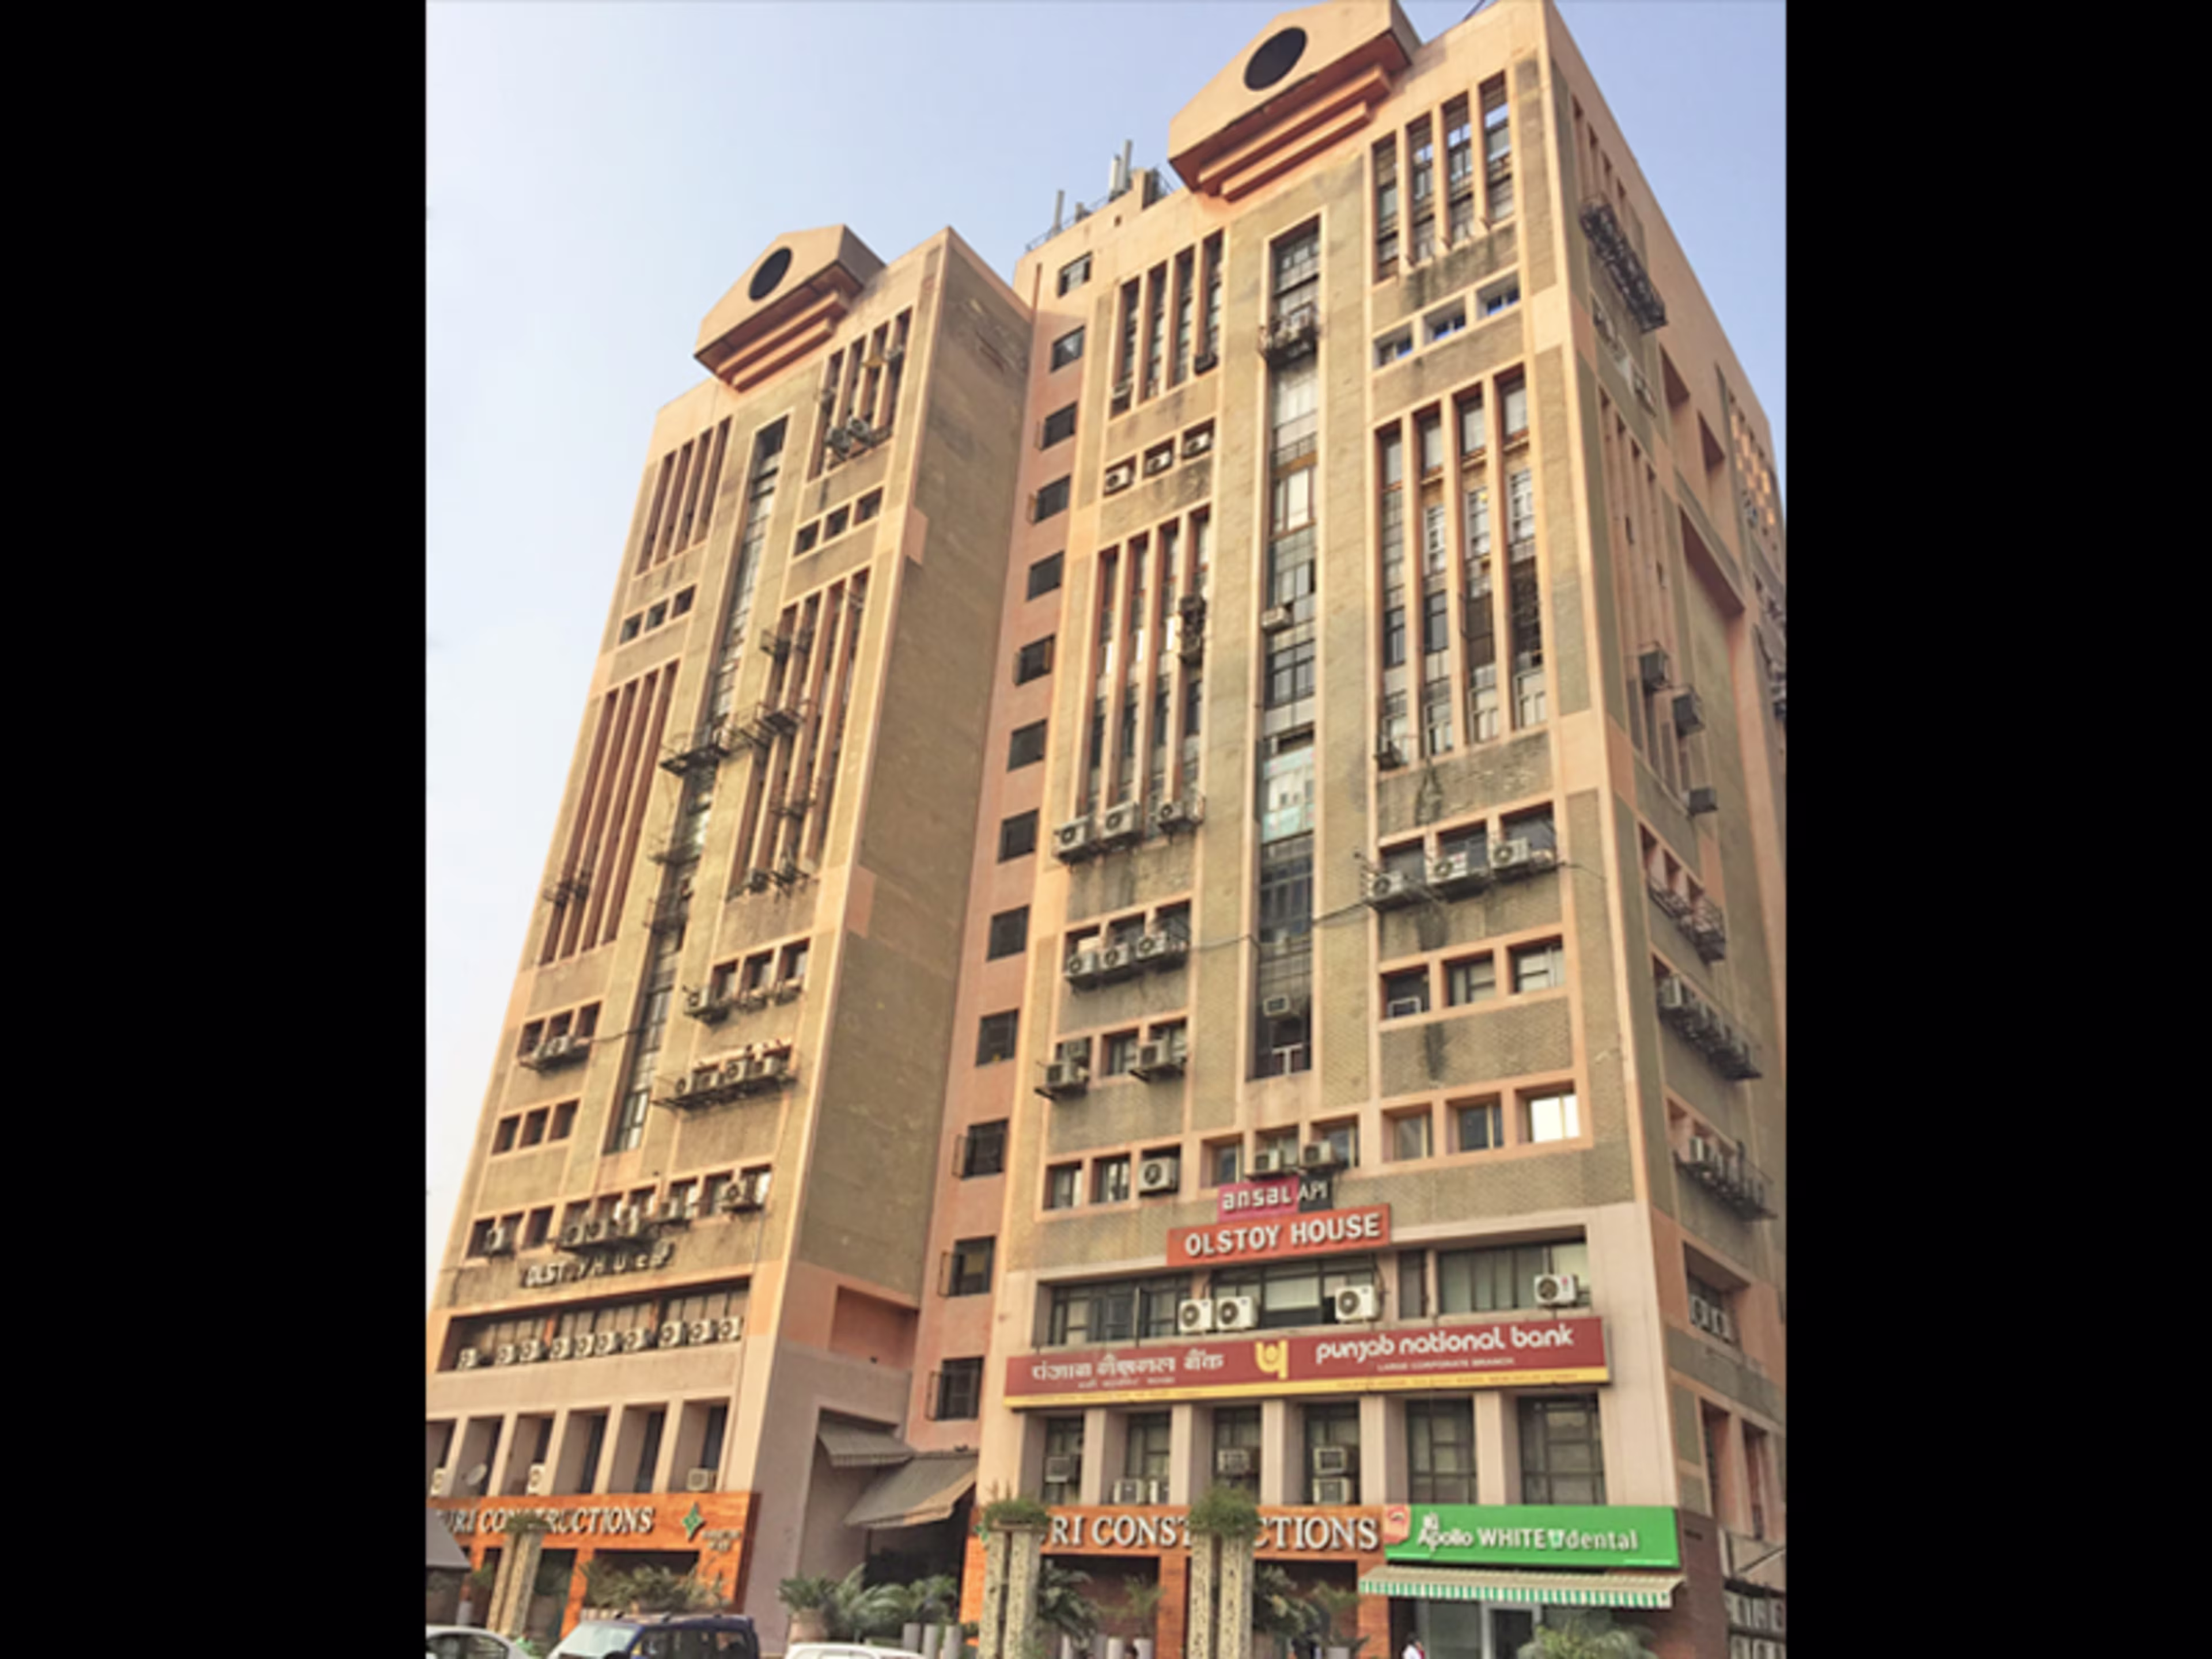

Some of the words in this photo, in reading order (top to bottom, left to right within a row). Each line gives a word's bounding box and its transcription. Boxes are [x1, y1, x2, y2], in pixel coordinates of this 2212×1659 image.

[1184, 1224, 1282, 1256] OLSTOY
[1290, 1213, 1381, 1245] HOUSE
[1316, 1334, 1395, 1364] punjab
[1399, 1327, 1505, 1355] national
[1511, 1323, 1574, 1348] bank
[1476, 1527, 1547, 1550] WHITE
[1565, 1529, 1639, 1551] dental
